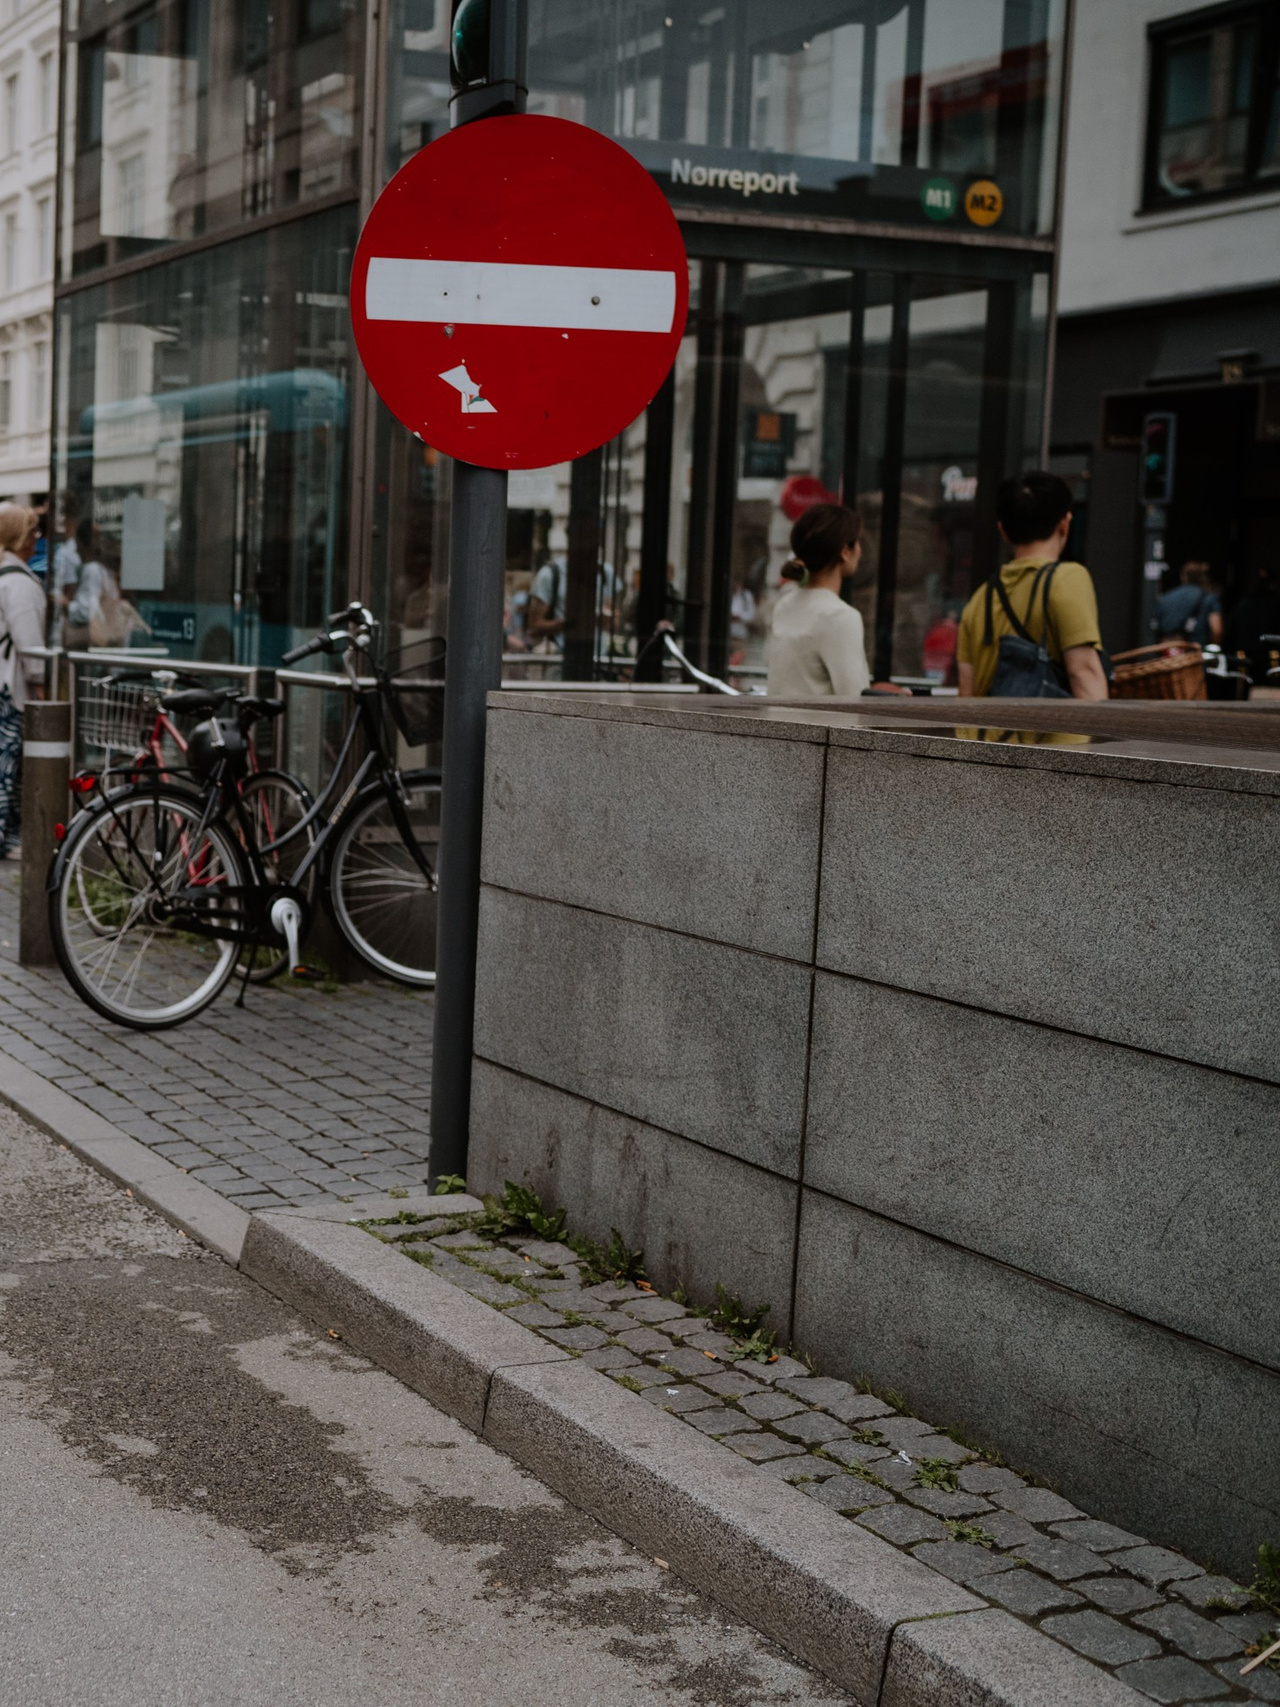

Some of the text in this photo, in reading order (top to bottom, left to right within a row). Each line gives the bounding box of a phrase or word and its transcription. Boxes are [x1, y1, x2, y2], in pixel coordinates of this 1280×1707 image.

[671, 158, 800, 196] Nørreport
[926, 188, 952, 209] M1
[970, 193, 999, 213] M2
